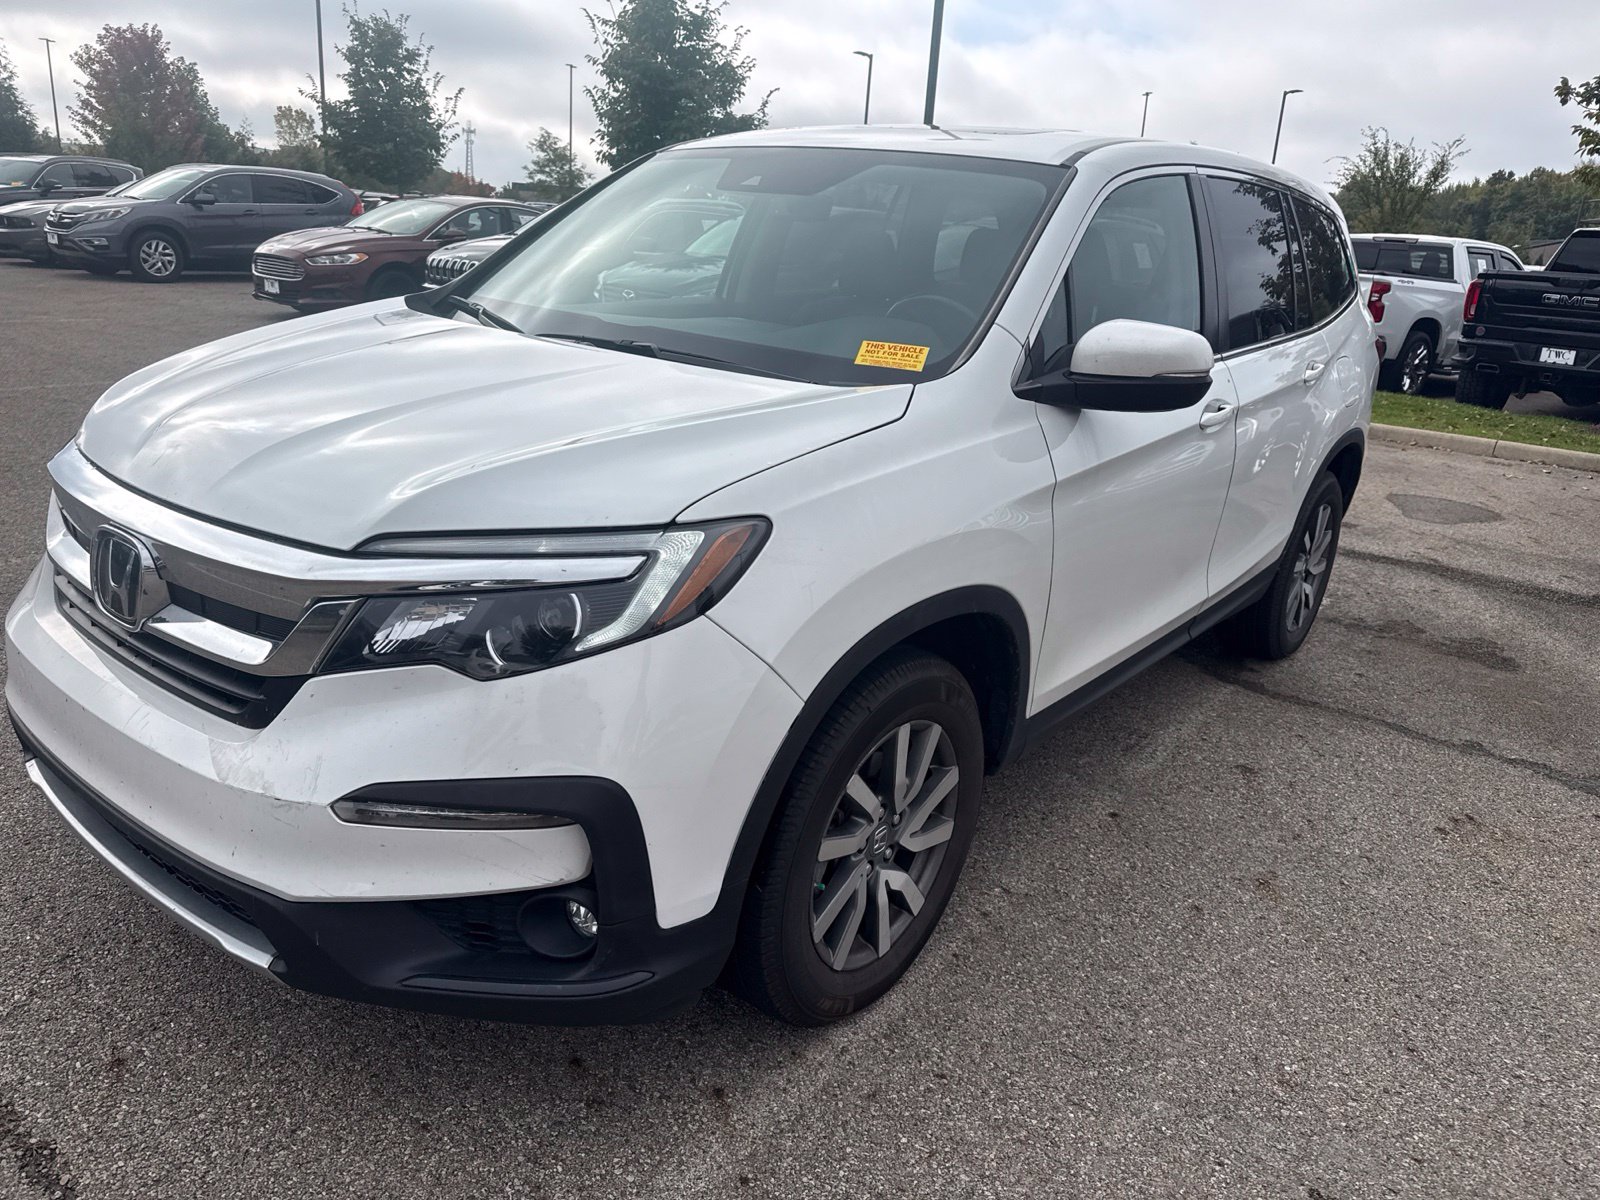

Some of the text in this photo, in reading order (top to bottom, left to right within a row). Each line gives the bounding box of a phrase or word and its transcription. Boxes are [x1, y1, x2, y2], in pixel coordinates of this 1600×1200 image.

[1541, 293, 1600, 307] GMC
[865, 342, 926, 354] THIS VEHICLE
[900, 352, 920, 360] SALE
[1546, 349, 1571, 360] TWC
